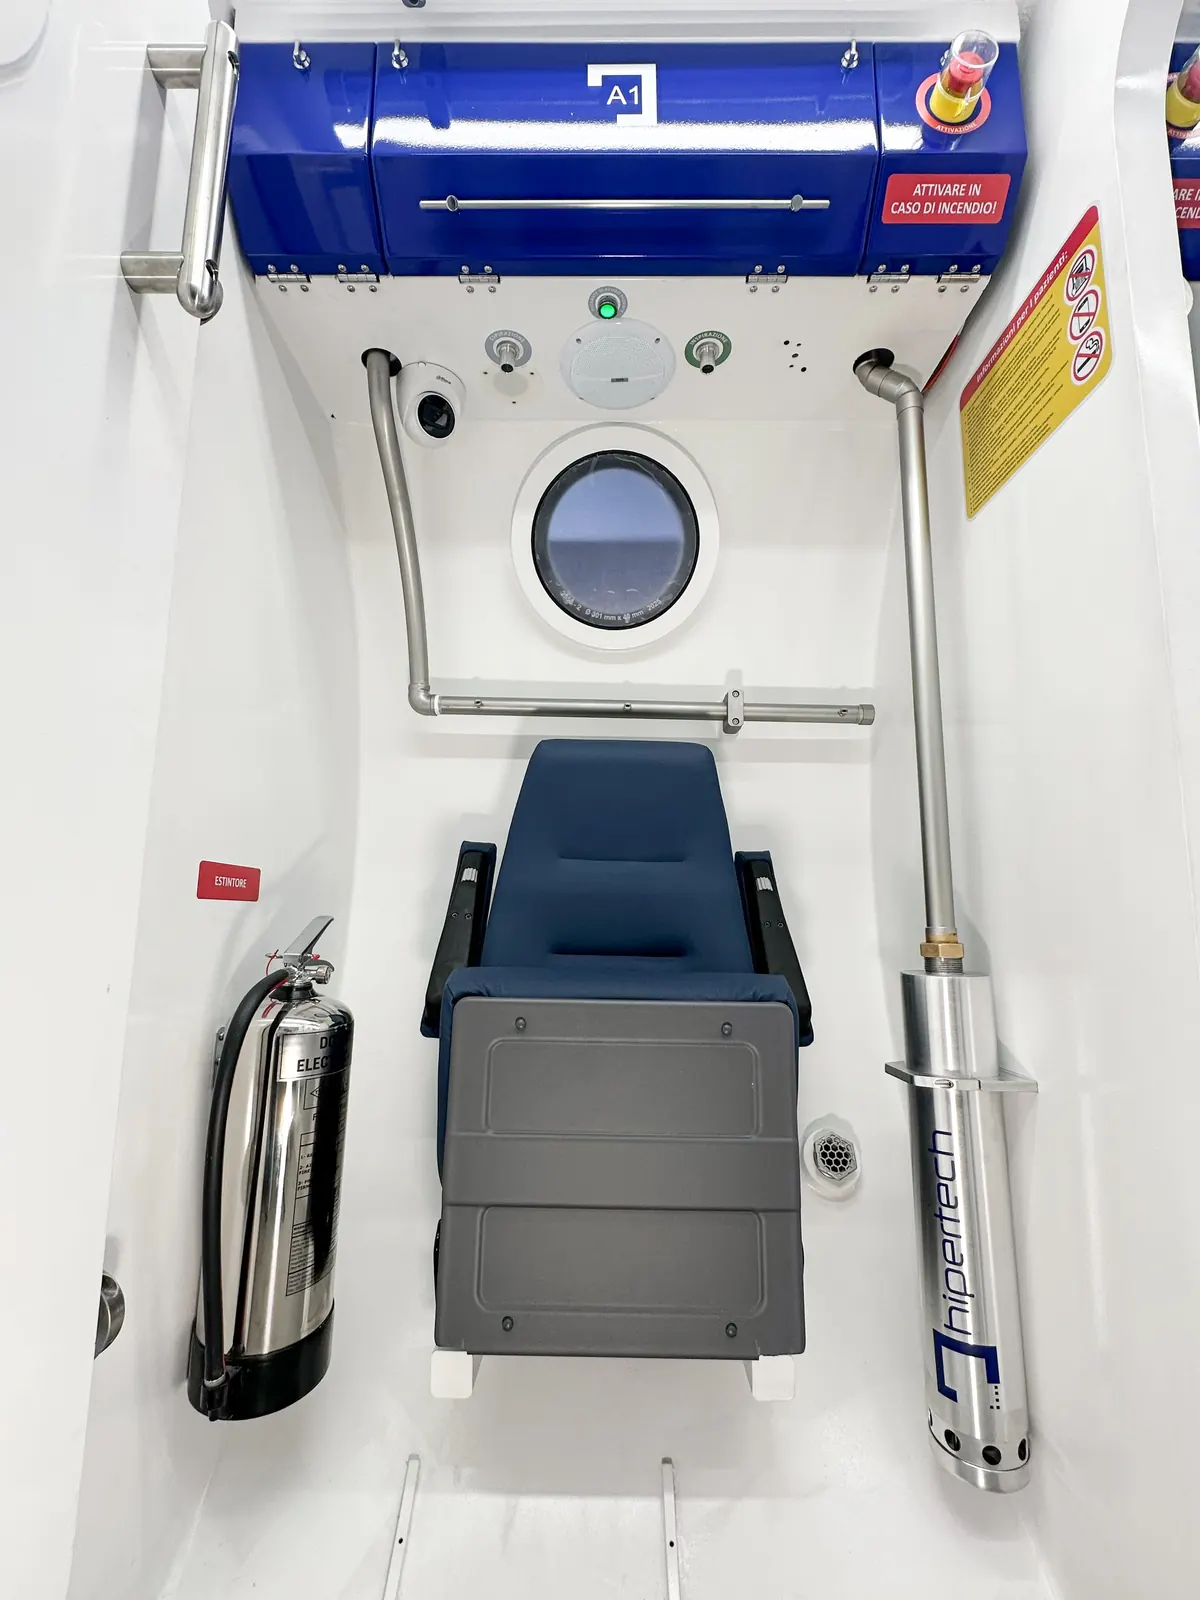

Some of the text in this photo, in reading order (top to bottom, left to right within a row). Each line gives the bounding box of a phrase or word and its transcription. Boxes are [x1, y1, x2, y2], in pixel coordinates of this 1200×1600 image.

[606, 85, 639, 105] A1
[935, 121, 977, 133] ATTIVAZIONE
[912, 183, 982, 196] ATTIVARE IN
[890, 201, 998, 214] CASO DI INCENDIO!
[1016, 305, 1029, 329] per
[1033, 250, 1068, 304] pazienti:
[214, 876, 247, 888] ESTINTORE
[296, 1055, 331, 1072] ELEC
[928, 1130, 975, 1335] hipertech
